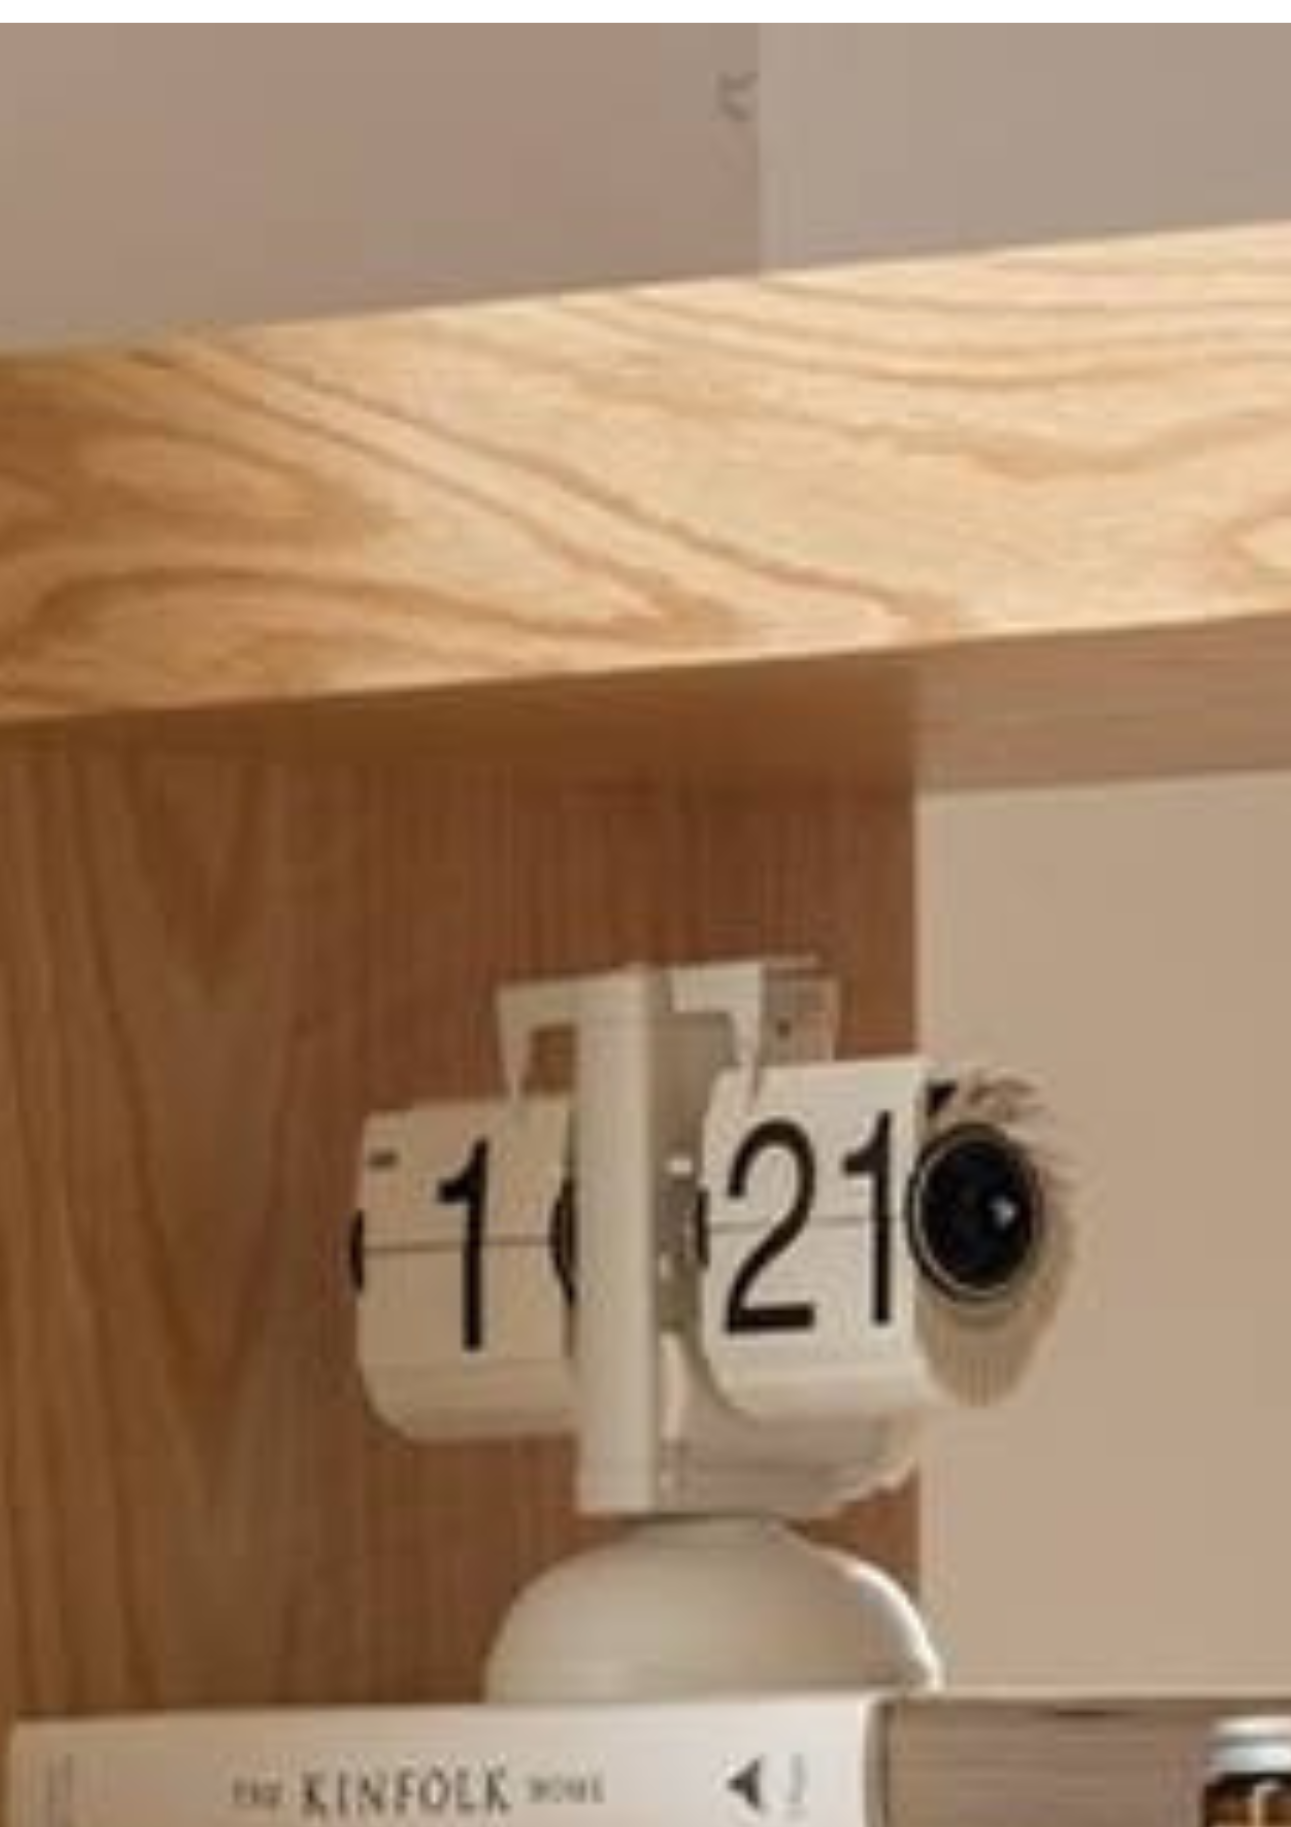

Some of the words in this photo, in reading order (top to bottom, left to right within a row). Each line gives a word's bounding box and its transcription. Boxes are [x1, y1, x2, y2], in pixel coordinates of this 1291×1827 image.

[437, 1135, 490, 1352] 1
[724, 1110, 893, 1334] 21
[302, 1764, 512, 1819] KINFOLK
